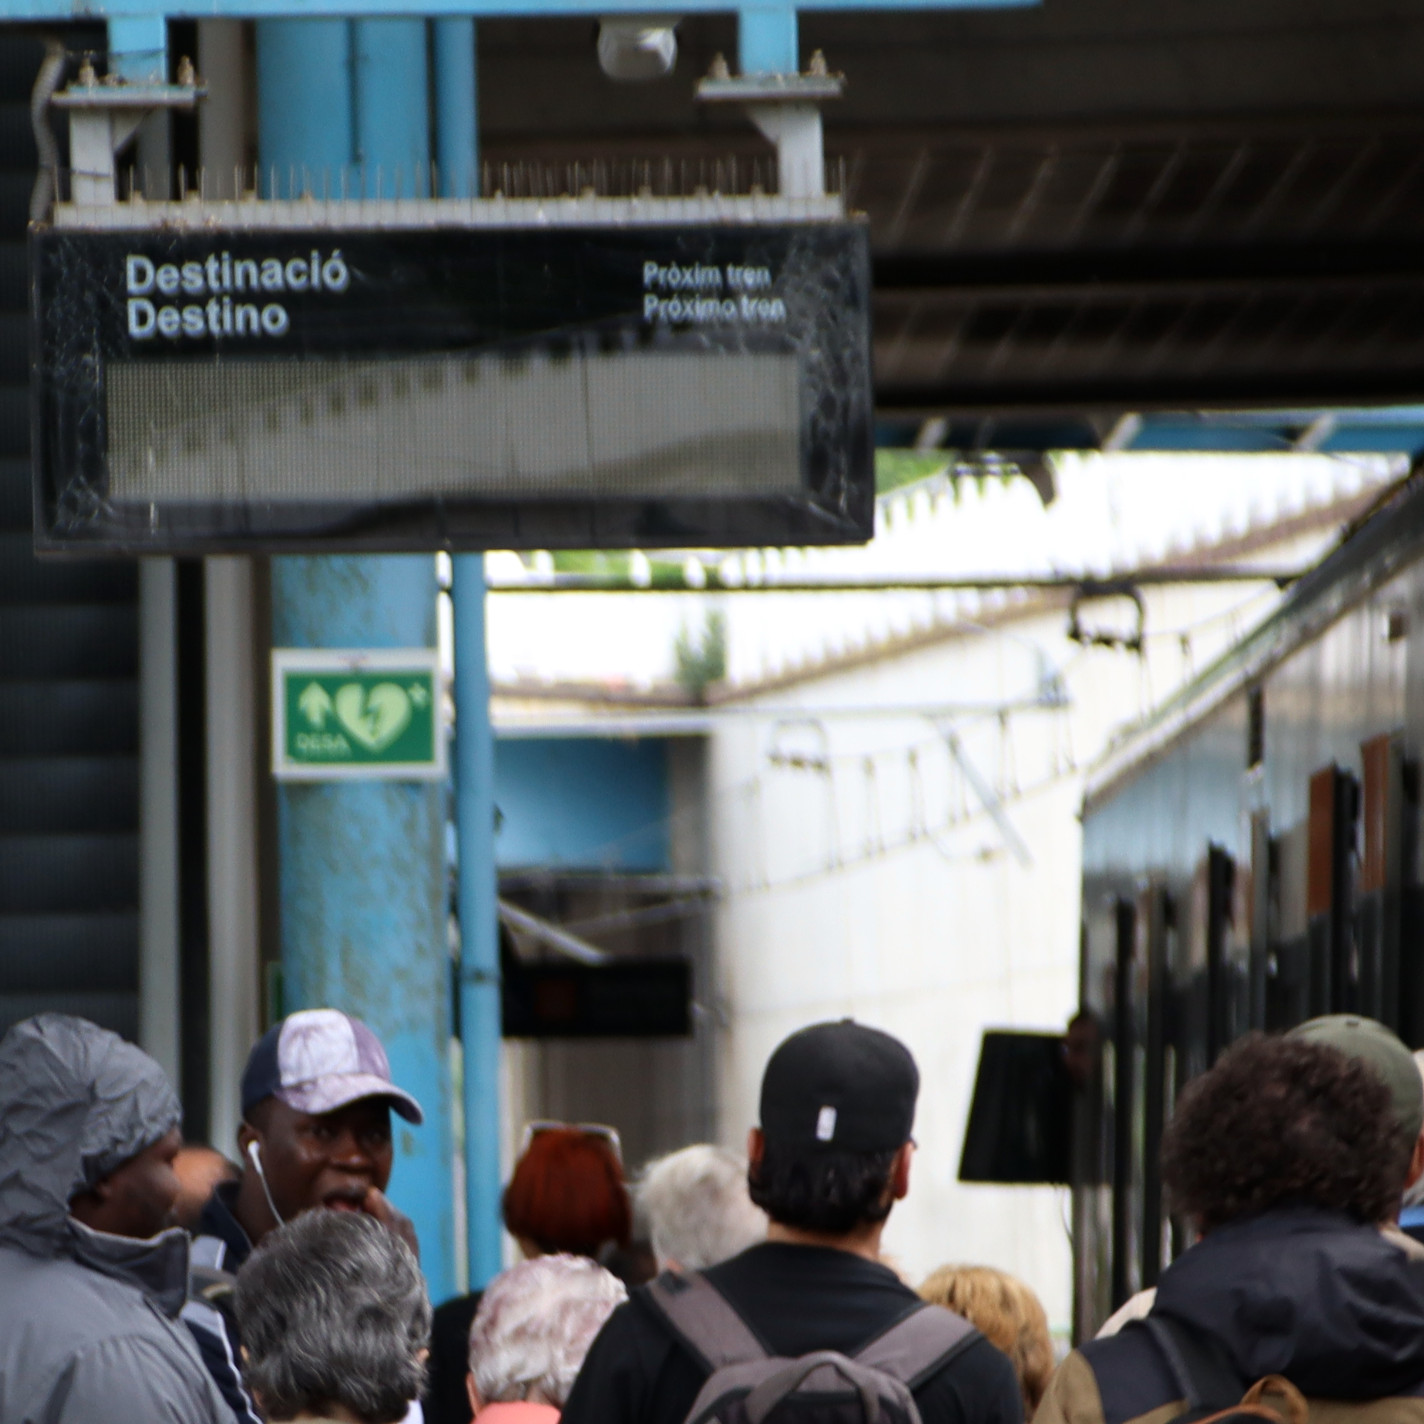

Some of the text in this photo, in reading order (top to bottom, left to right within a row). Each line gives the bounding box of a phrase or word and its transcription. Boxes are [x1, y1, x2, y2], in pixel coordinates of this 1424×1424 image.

[126, 249, 349, 296] Destinació
[726, 262, 772, 288] tren
[127, 295, 289, 338] Destino
[643, 293, 787, 323] Próximo tren
